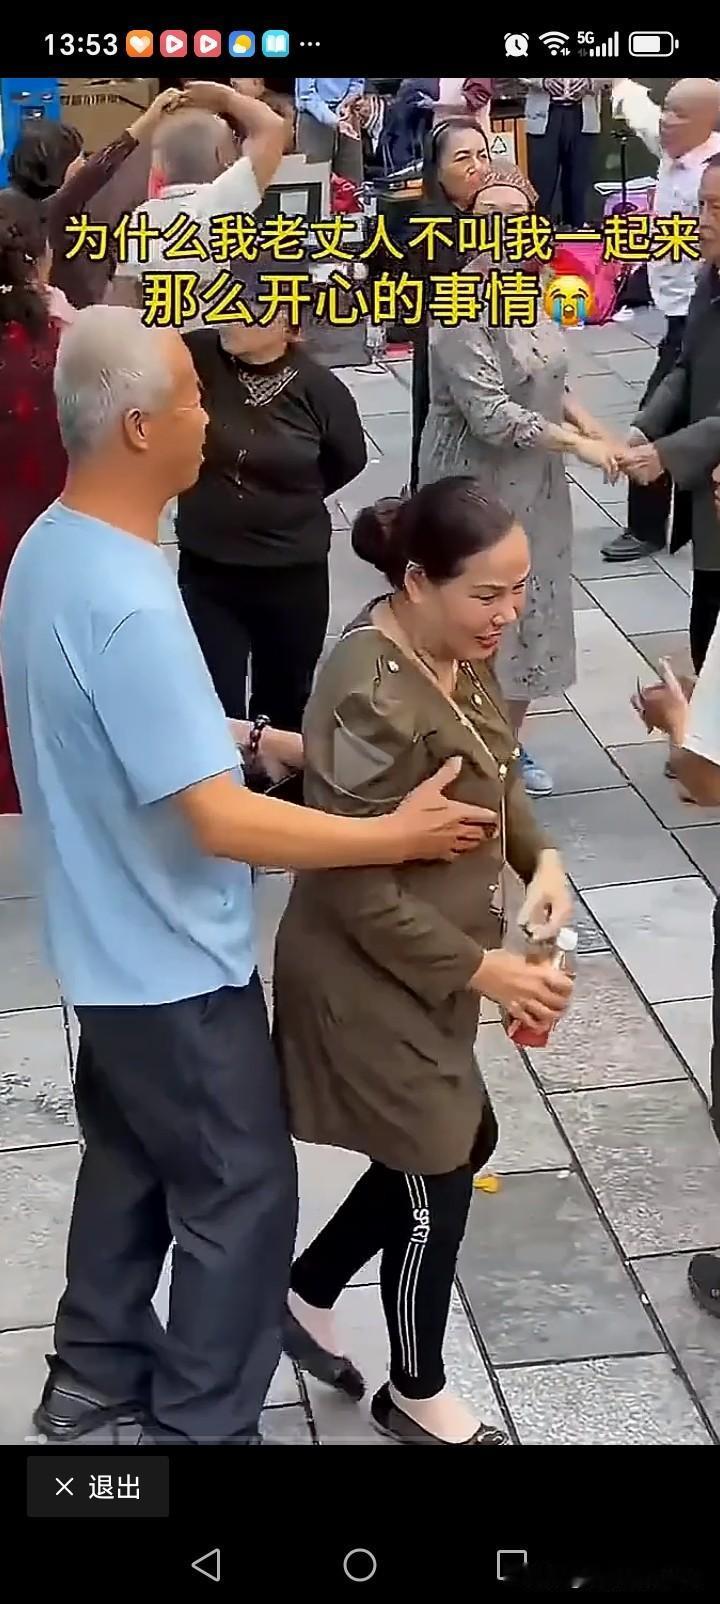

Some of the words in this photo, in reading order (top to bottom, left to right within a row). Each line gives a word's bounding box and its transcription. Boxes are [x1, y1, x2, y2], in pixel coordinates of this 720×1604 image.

[44, 32, 118, 56] 13:53
[577, 30, 595, 44] 5G
[88, 1473, 141, 1500] 退出
